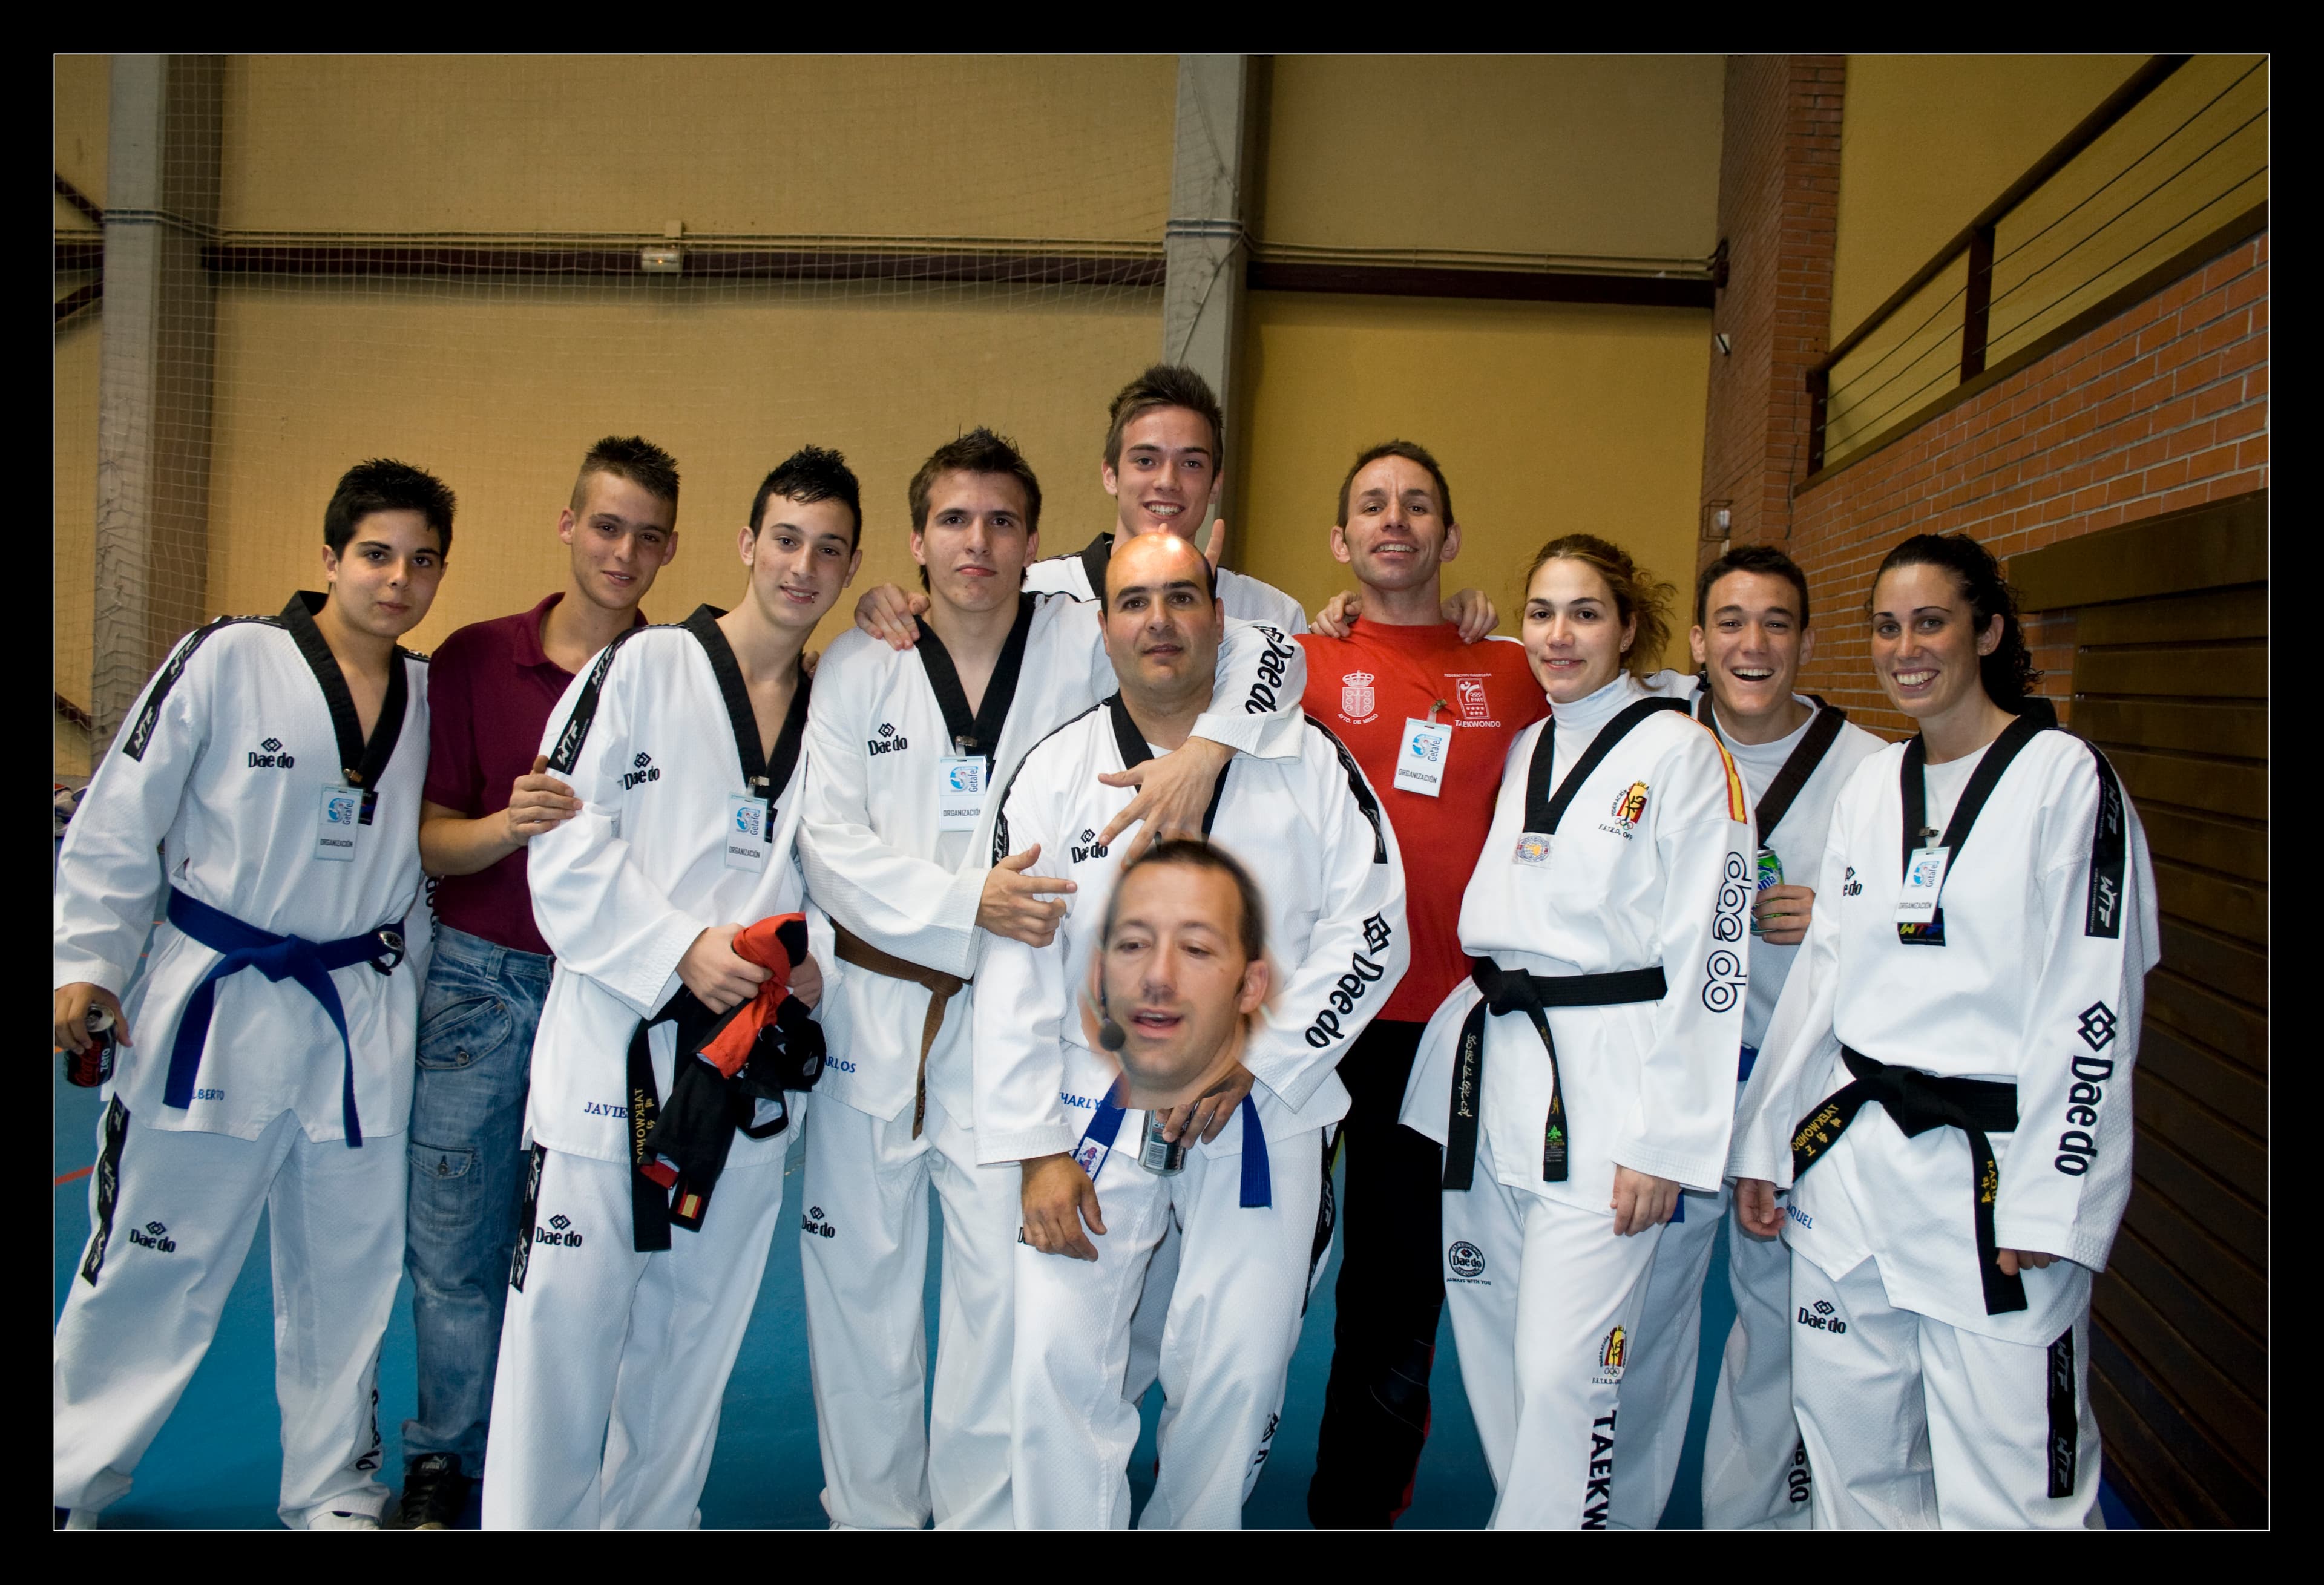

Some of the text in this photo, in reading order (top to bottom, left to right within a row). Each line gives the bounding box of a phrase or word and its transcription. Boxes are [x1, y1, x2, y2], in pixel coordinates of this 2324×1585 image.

[1428, 740, 1441, 761] Getafe
[968, 769, 978, 792] Getafe
[1399, 769, 1437, 783] ORGANIZACIÓN
[343, 803, 354, 825] Getafe
[750, 813, 760, 835] Getafe
[729, 846, 760, 858] ORGANIZACIÓN
[1926, 864, 1937, 887] Getafe
[1843, 880, 1862, 896] edo
[2098, 876, 2117, 928] WTF
[100, 1048, 111, 1073] zero
[824, 1056, 856, 1073] RLOS
[584, 1101, 628, 1118] JAVIE
[1060, 1092, 1102, 1111] HARLY
